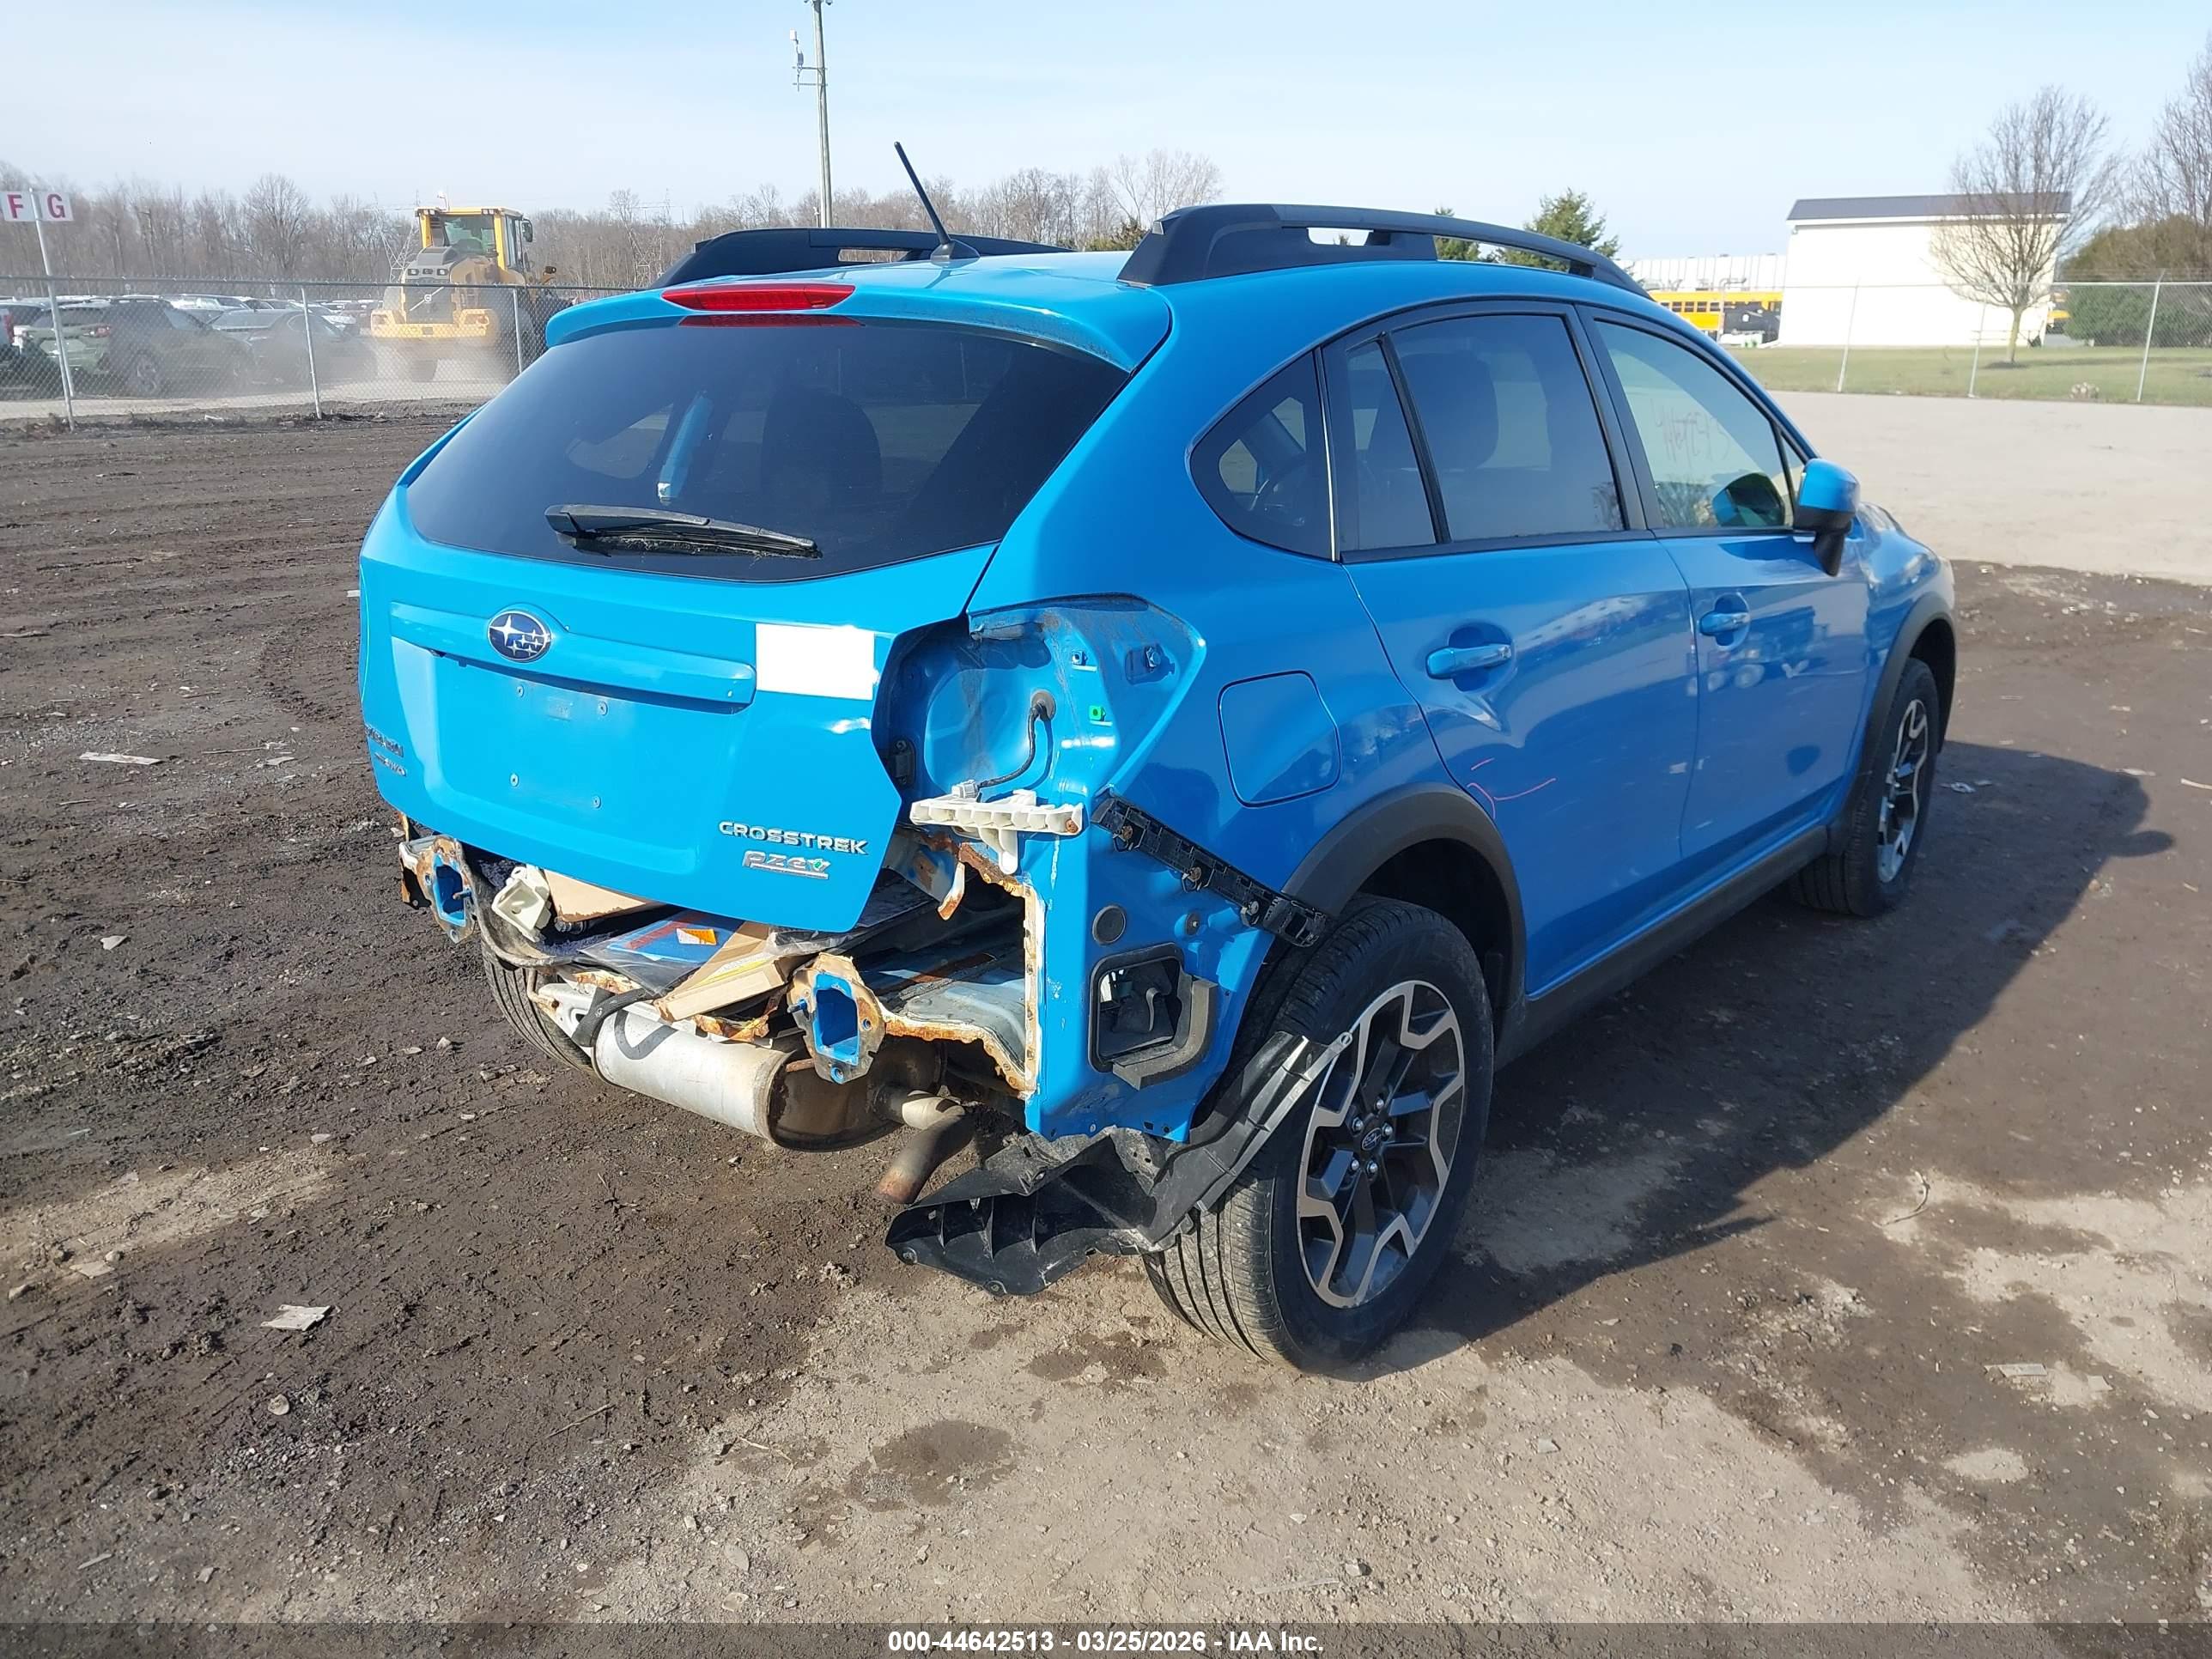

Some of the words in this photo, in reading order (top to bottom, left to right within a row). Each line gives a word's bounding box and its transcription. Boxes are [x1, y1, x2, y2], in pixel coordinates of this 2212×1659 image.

[7, 194, 24, 219] F
[47, 193, 66, 218] G
[719, 821, 869, 855] CROSSTREK
